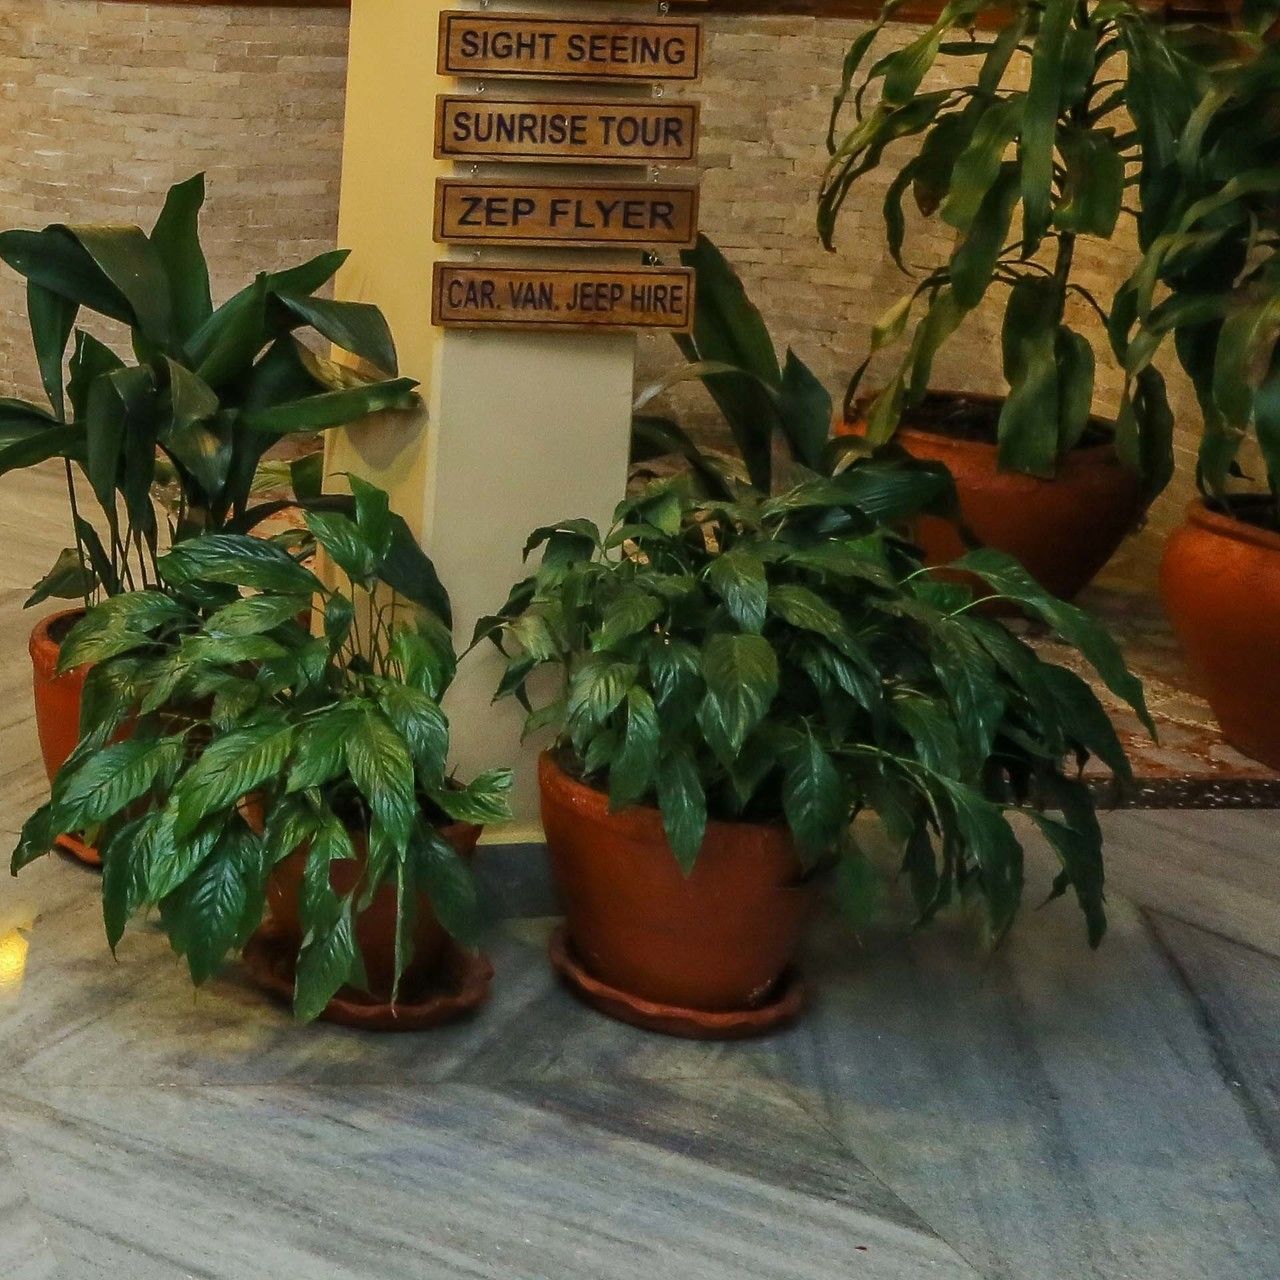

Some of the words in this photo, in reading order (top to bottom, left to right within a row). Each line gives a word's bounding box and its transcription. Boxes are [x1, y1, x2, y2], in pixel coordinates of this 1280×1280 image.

[460, 30, 558, 61] SIGHT
[566, 34, 686, 65] SEEING
[453, 111, 588, 146] SUNRISE
[597, 115, 684, 147] TOUR
[457, 196, 536, 227] ZEP
[548, 199, 675, 230] FLYER
[566, 282, 625, 312] JEEP
[630, 285, 684, 316] HIRE
